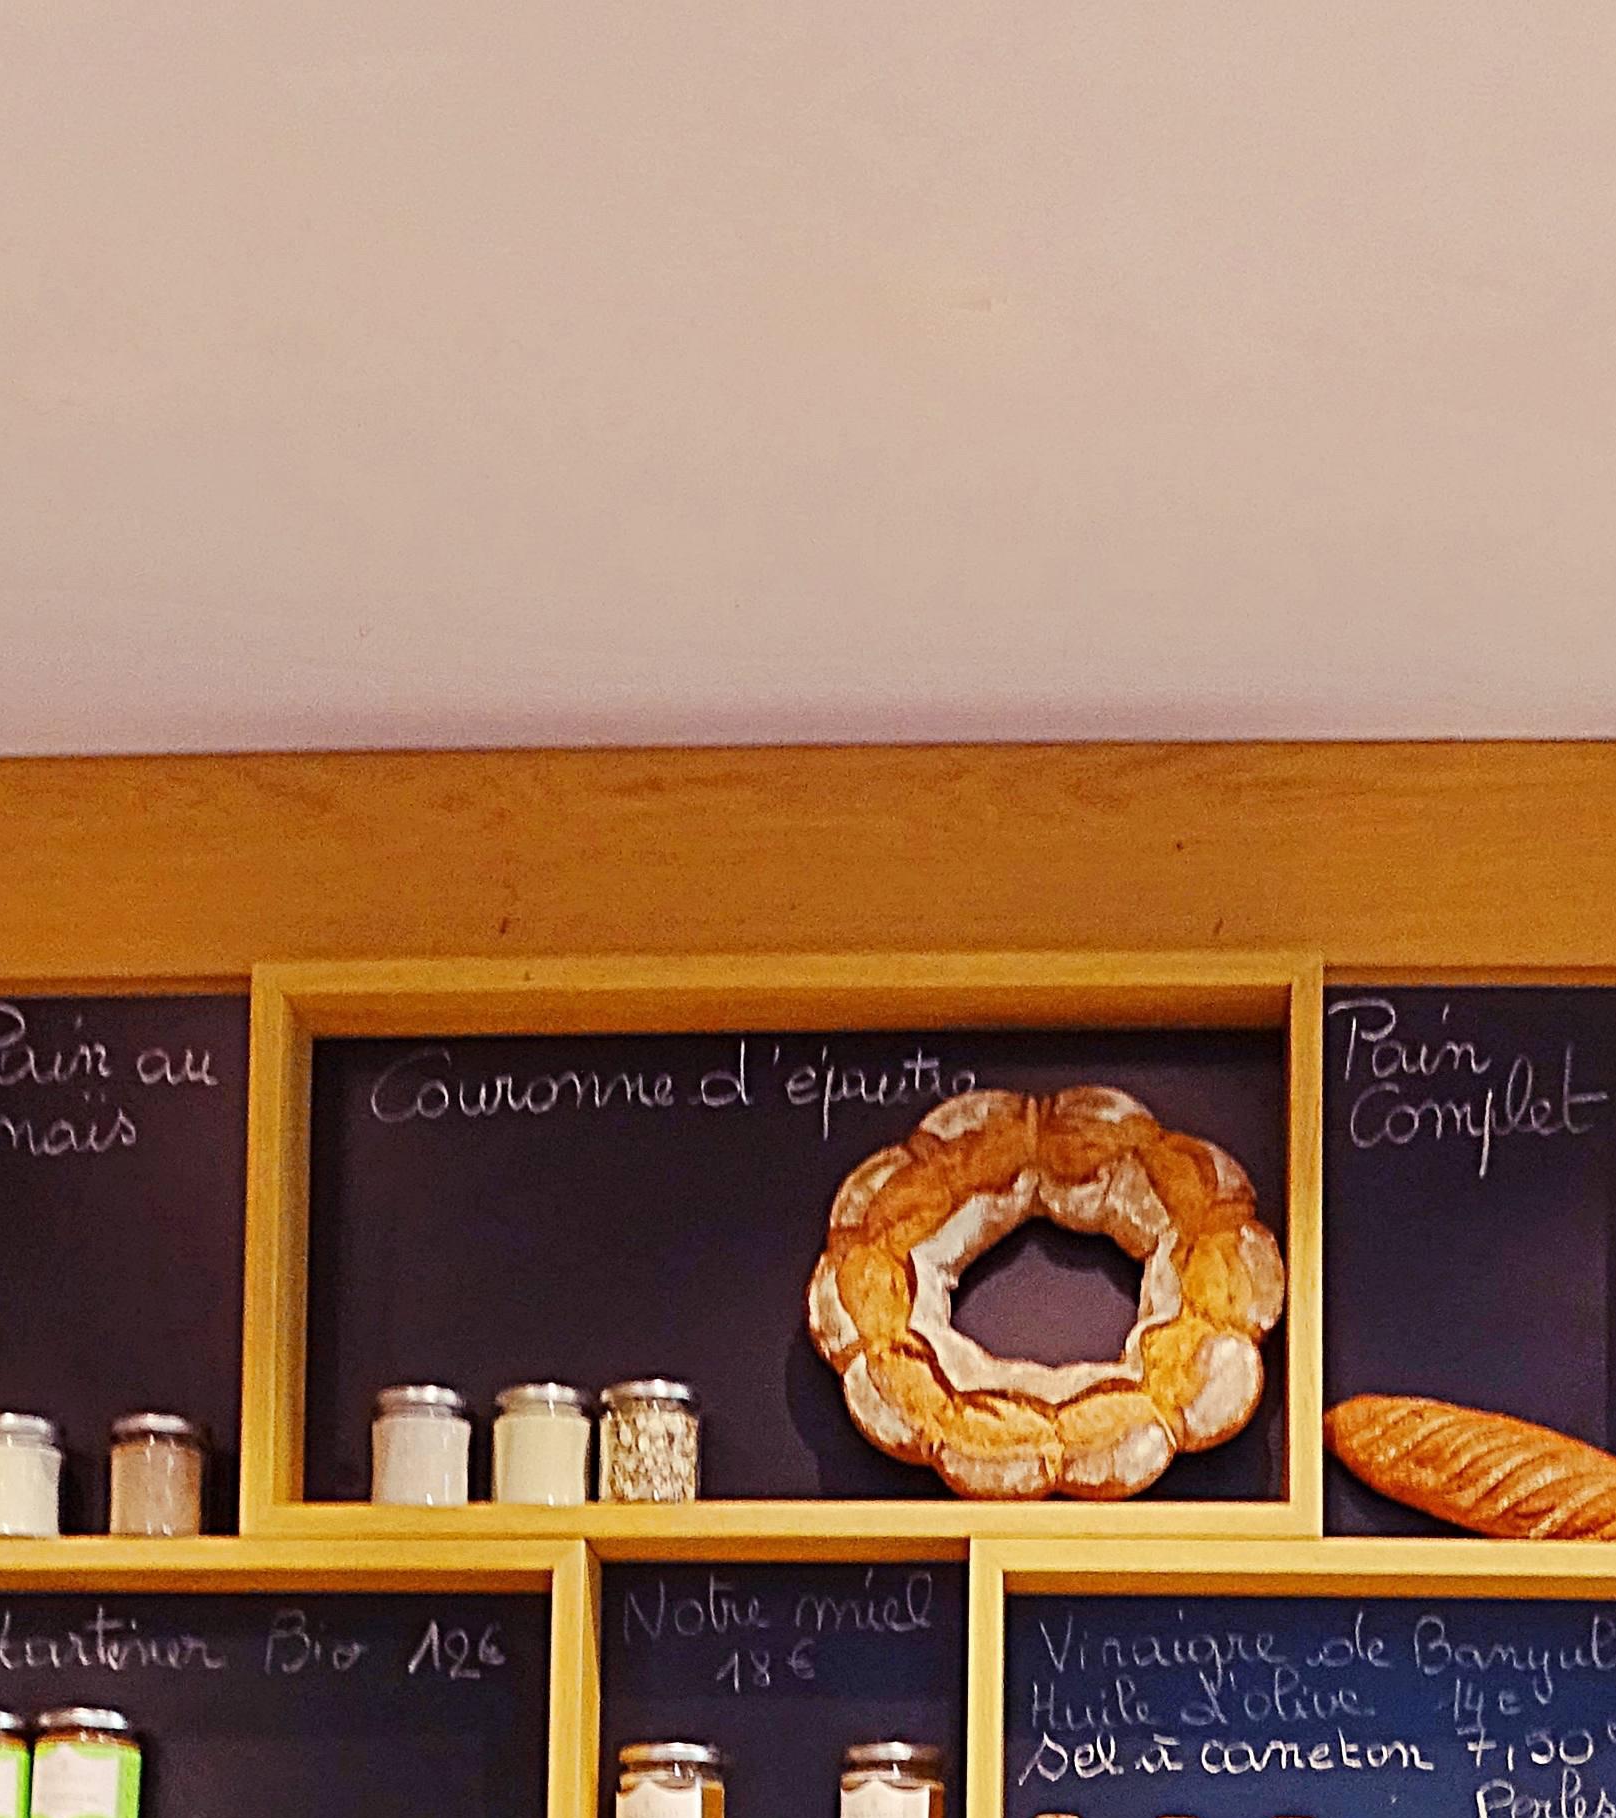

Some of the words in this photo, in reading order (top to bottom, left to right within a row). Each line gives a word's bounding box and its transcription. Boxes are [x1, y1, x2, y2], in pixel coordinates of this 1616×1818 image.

[136, 1048, 219, 1087] au
[1328, 997, 1492, 1081] Pain
[370, 1045, 674, 1123] Couronne
[263, 1608, 361, 1675] Bio
[623, 1573, 769, 1644] Notre
[795, 1567, 932, 1633] miel
[1039, 1609, 1287, 1690] Vinaigre
[1305, 1610, 1400, 1668] de
[1031, 1675, 1159, 1730] Huile
[1179, 1667, 1376, 1725] d'olive
